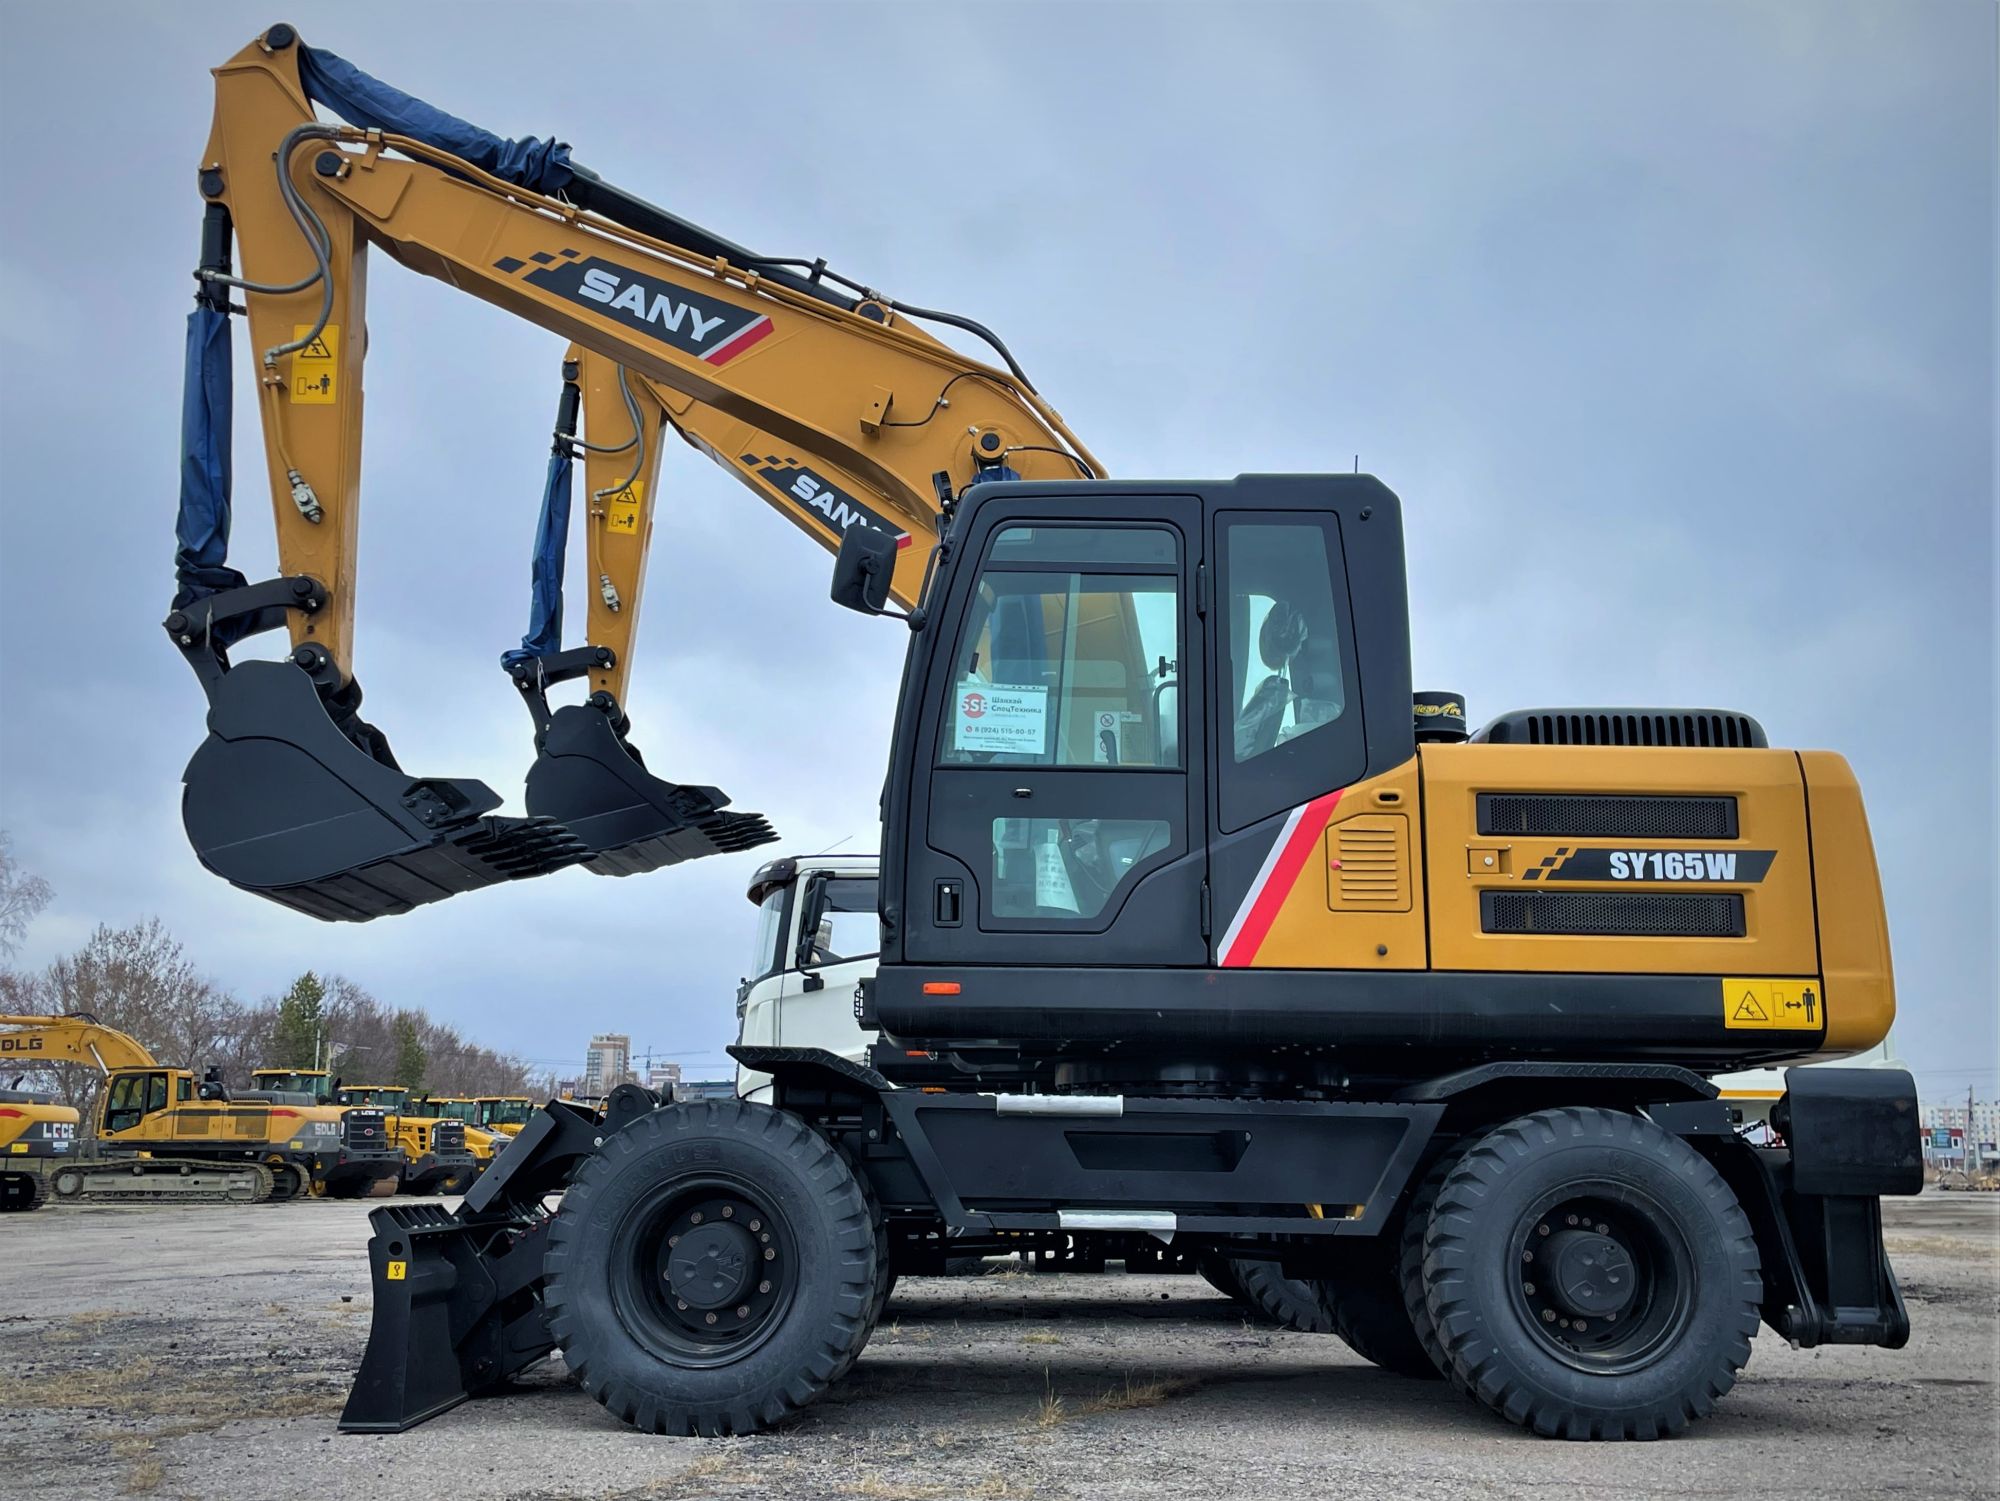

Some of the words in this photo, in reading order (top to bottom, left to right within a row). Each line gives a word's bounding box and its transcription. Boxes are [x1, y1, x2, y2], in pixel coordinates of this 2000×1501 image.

[578, 268, 726, 342] SANY
[790, 474, 882, 532] SAN
[991, 704, 1042, 715] СпецТехника
[1609, 851, 1737, 880] SY165W
[314, 1122, 336, 1136] SDLG
